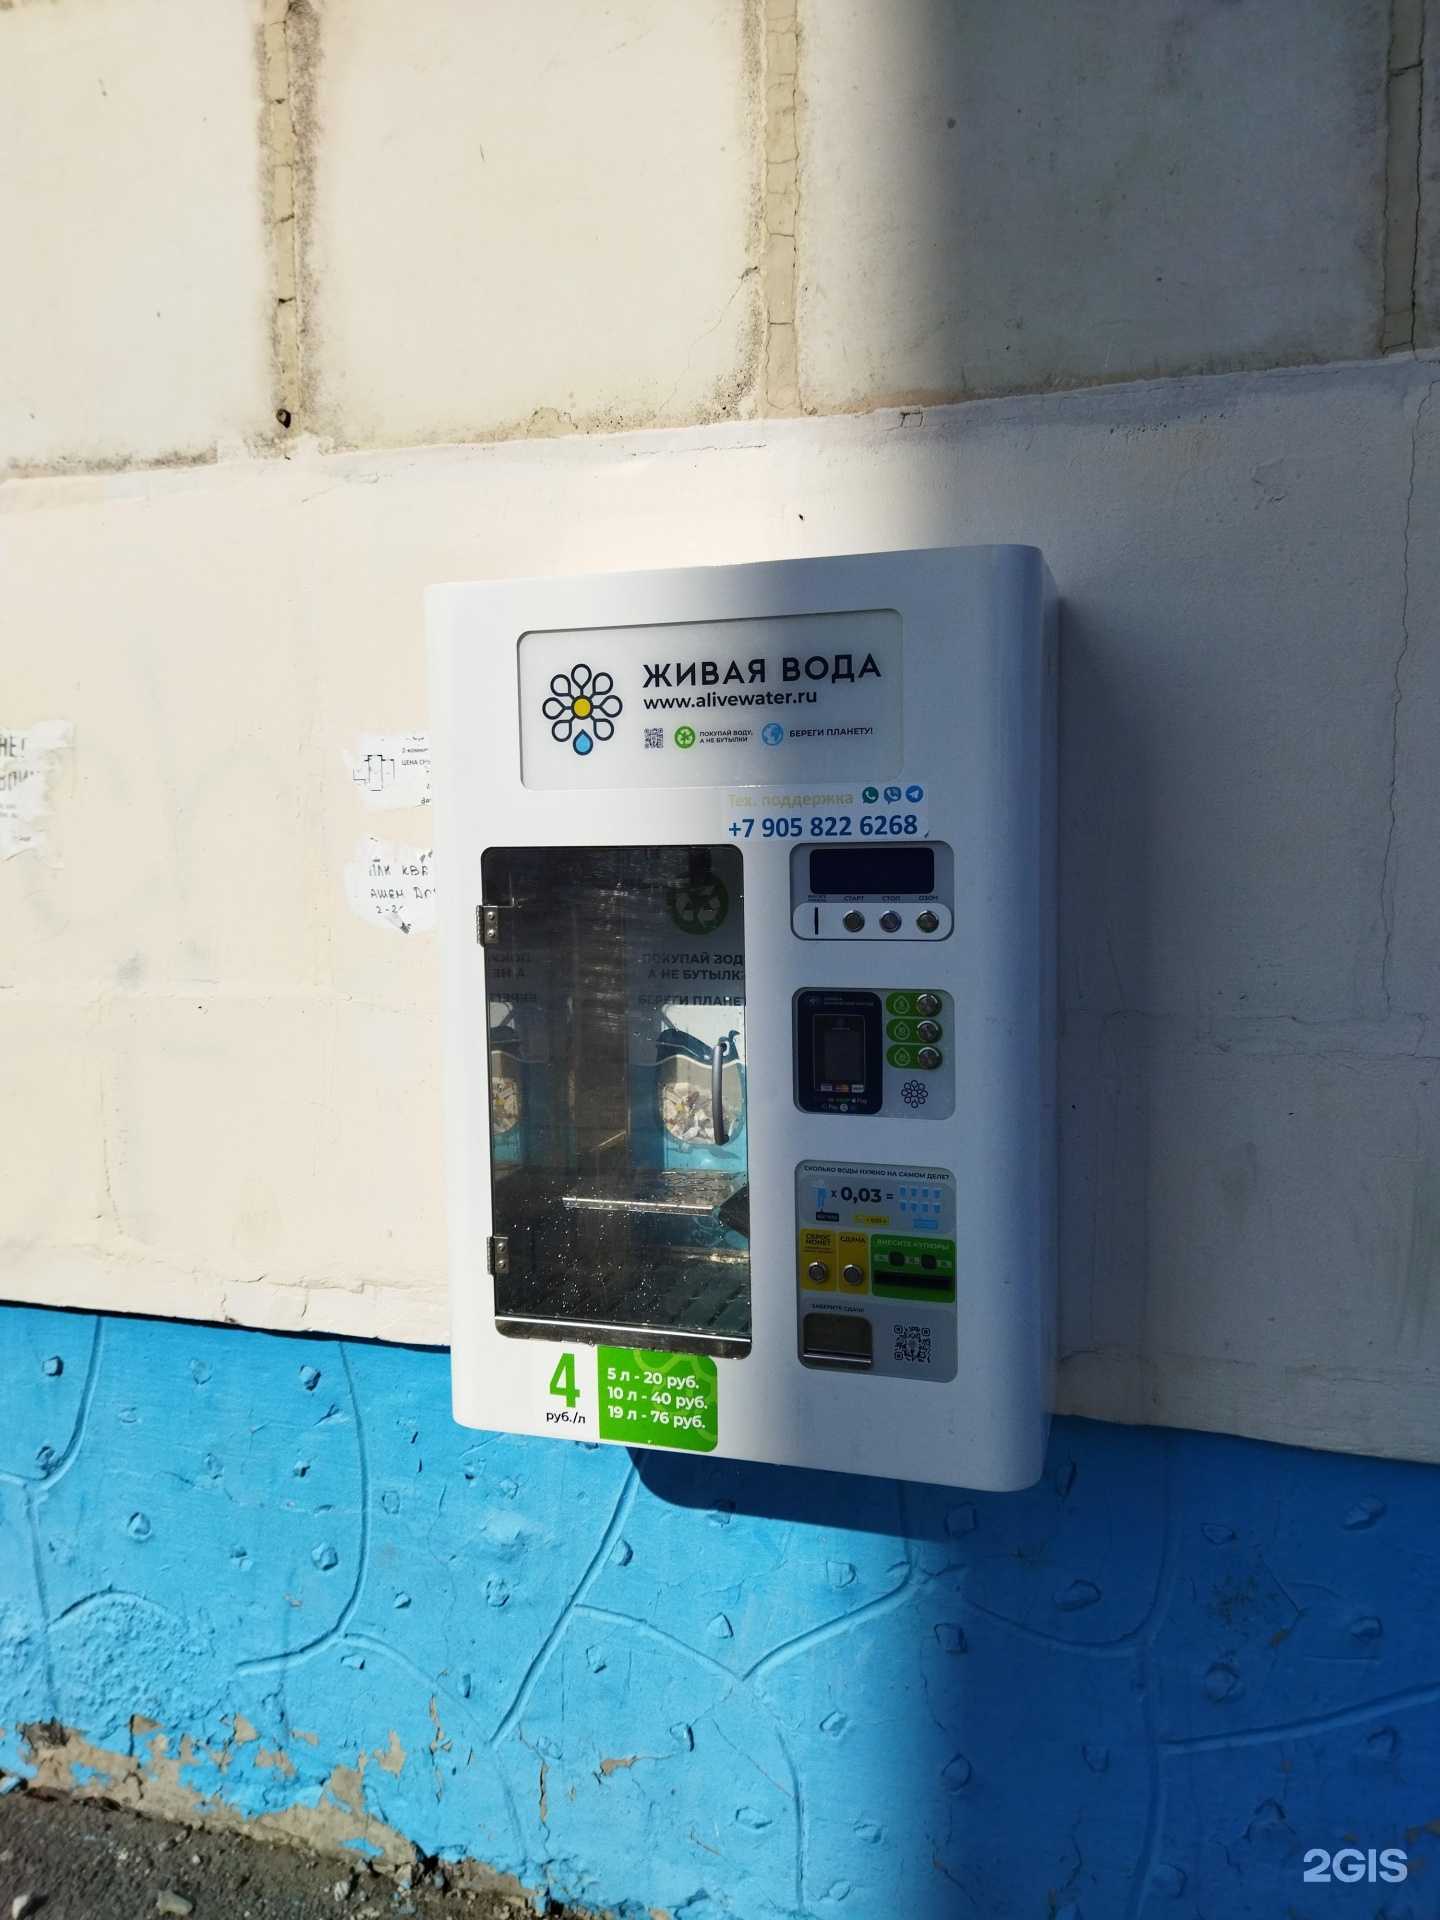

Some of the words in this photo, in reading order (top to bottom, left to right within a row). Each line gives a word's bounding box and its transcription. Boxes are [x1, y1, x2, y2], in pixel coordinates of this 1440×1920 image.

[642, 658, 766, 689] ЖИВАЯ
[782, 653, 882, 684] ВОДА
[643, 690, 818, 711] www.alivewater.ru
[789, 729, 825, 738] БЕРЕГИ
[826, 727, 873, 736] ПЛАНЕТУ!
[727, 794, 756, 807] Тех.
[762, 792, 854, 809] поддержка
[728, 818, 755, 838] +7
[761, 817, 803, 838] 905
[810, 816, 852, 837] 822
[859, 814, 918, 836] 6268
[840, 1186, 882, 1204] 0,03
[549, 1352, 580, 1408] 4
[607, 1367, 617, 1381] 5
[620, 1371, 630, 1382] л
[643, 1371, 663, 1385] 20
[666, 1374, 700, 1390] руб.
[607, 1386, 624, 1400] 10
[626, 1390, 637, 1401] л
[651, 1391, 672, 1406] 40
[675, 1395, 708, 1410] руб.
[546, 1411, 587, 1425] руб./л
[607, 1405, 624, 1419] 19
[626, 1409, 637, 1421] л
[650, 1410, 670, 1425] 76
[673, 1414, 707, 1430] руб.
